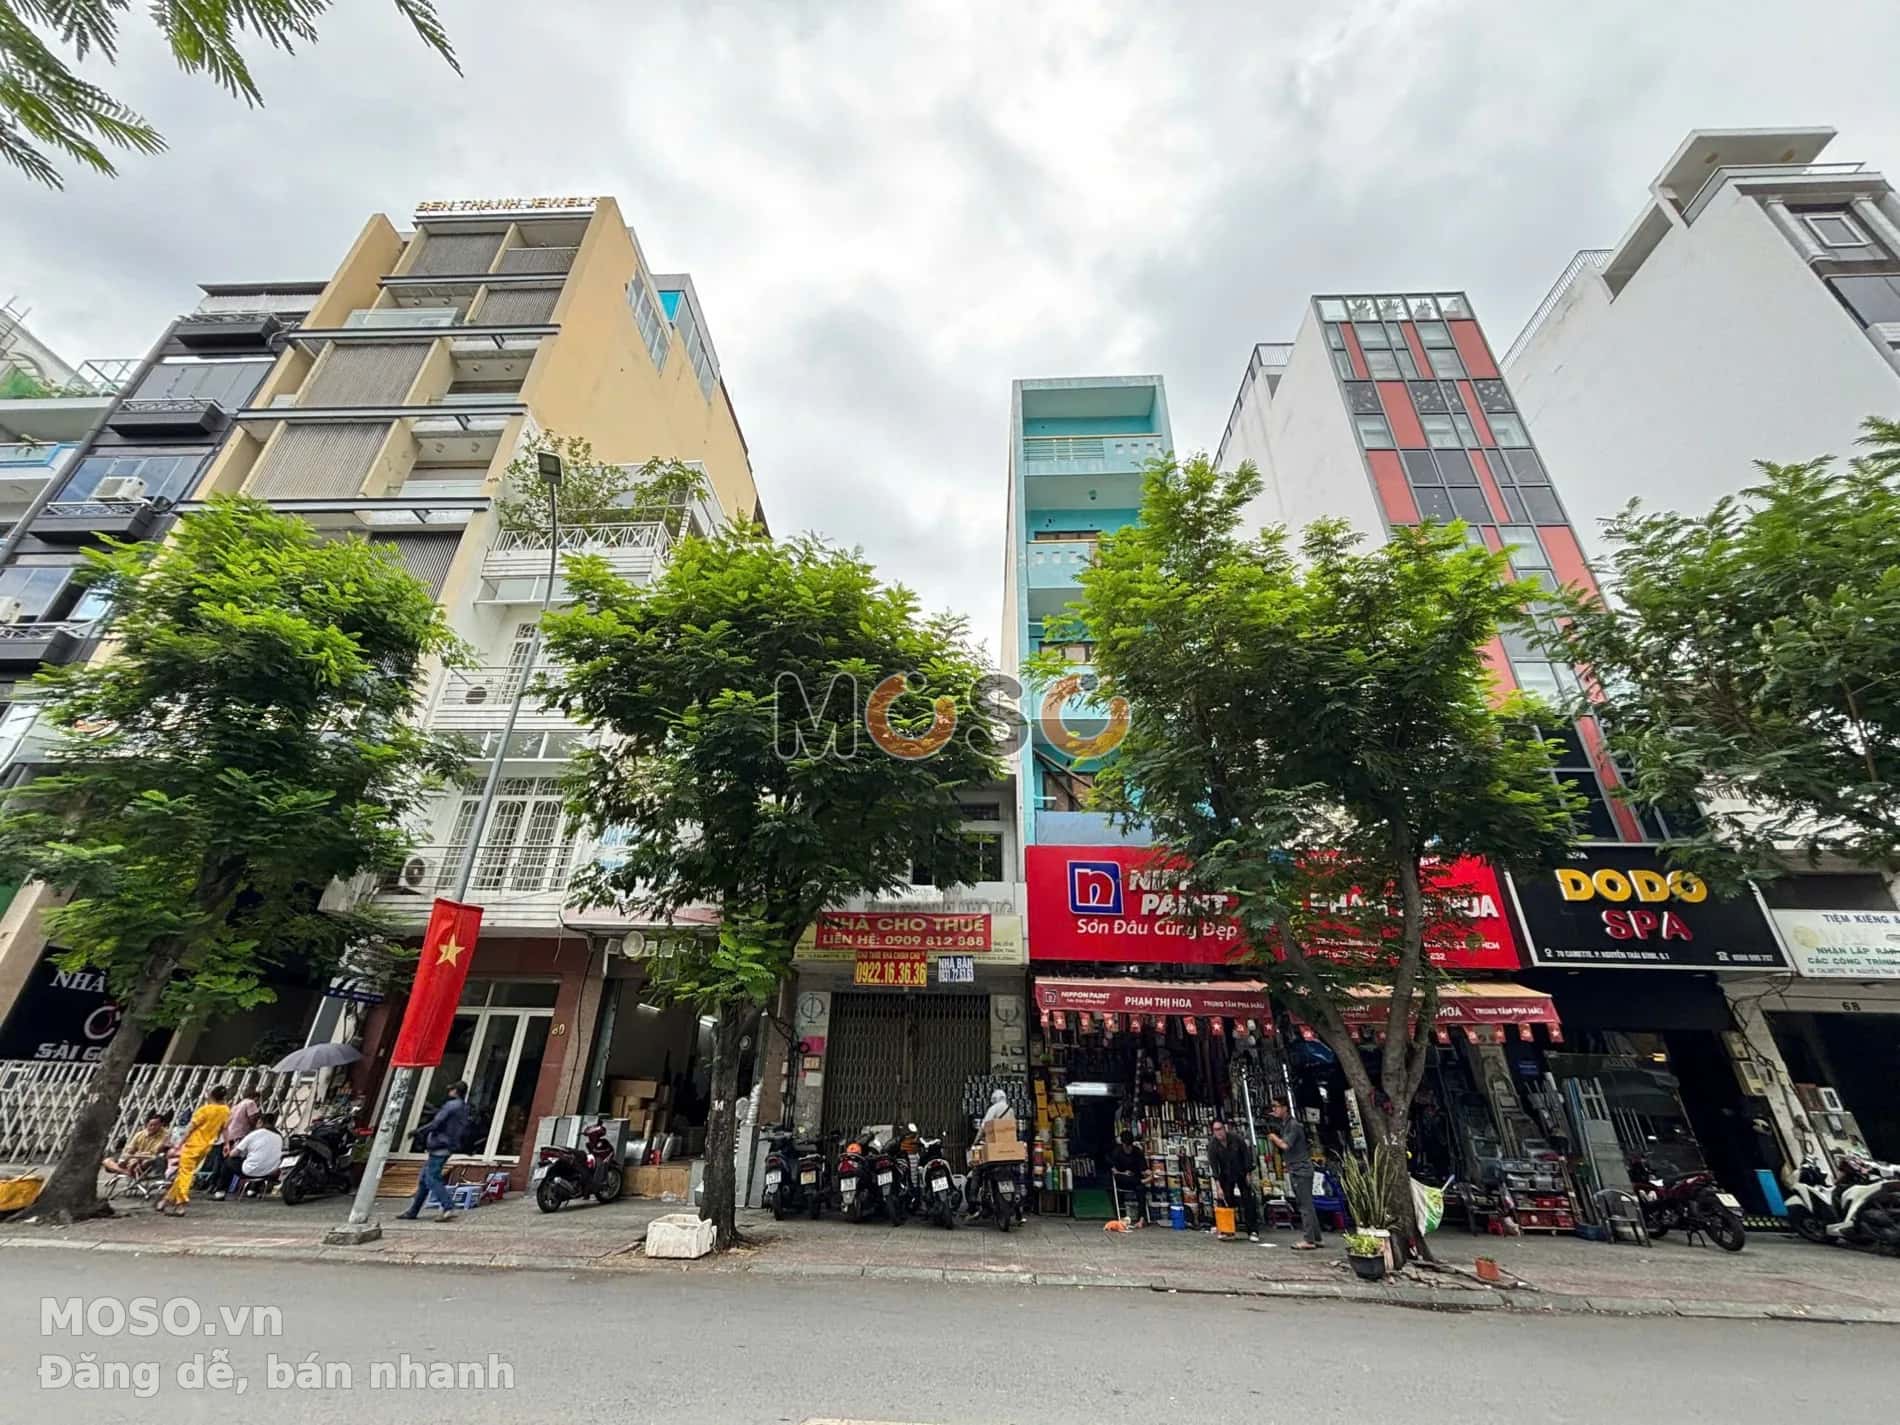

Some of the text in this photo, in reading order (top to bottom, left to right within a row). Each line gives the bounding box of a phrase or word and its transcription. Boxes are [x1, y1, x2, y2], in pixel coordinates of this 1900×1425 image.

[1554, 868, 1708, 903] DODO
[877, 917, 926, 932] CHO
[1077, 919, 1108, 934] Sơn
[1113, 919, 1148, 935] Đâu
[1202, 921, 1238, 941] Đẹp
[1601, 910, 1693, 941] SPA
[823, 931, 852, 945] LIÊN
[885, 935, 920, 946] 0909
[926, 935, 953, 946] 812
[856, 961, 927, 985] 0922.16.36.36
[1125, 996, 1154, 1009] PHẠM
[1171, 997, 1192, 1008] HOA
